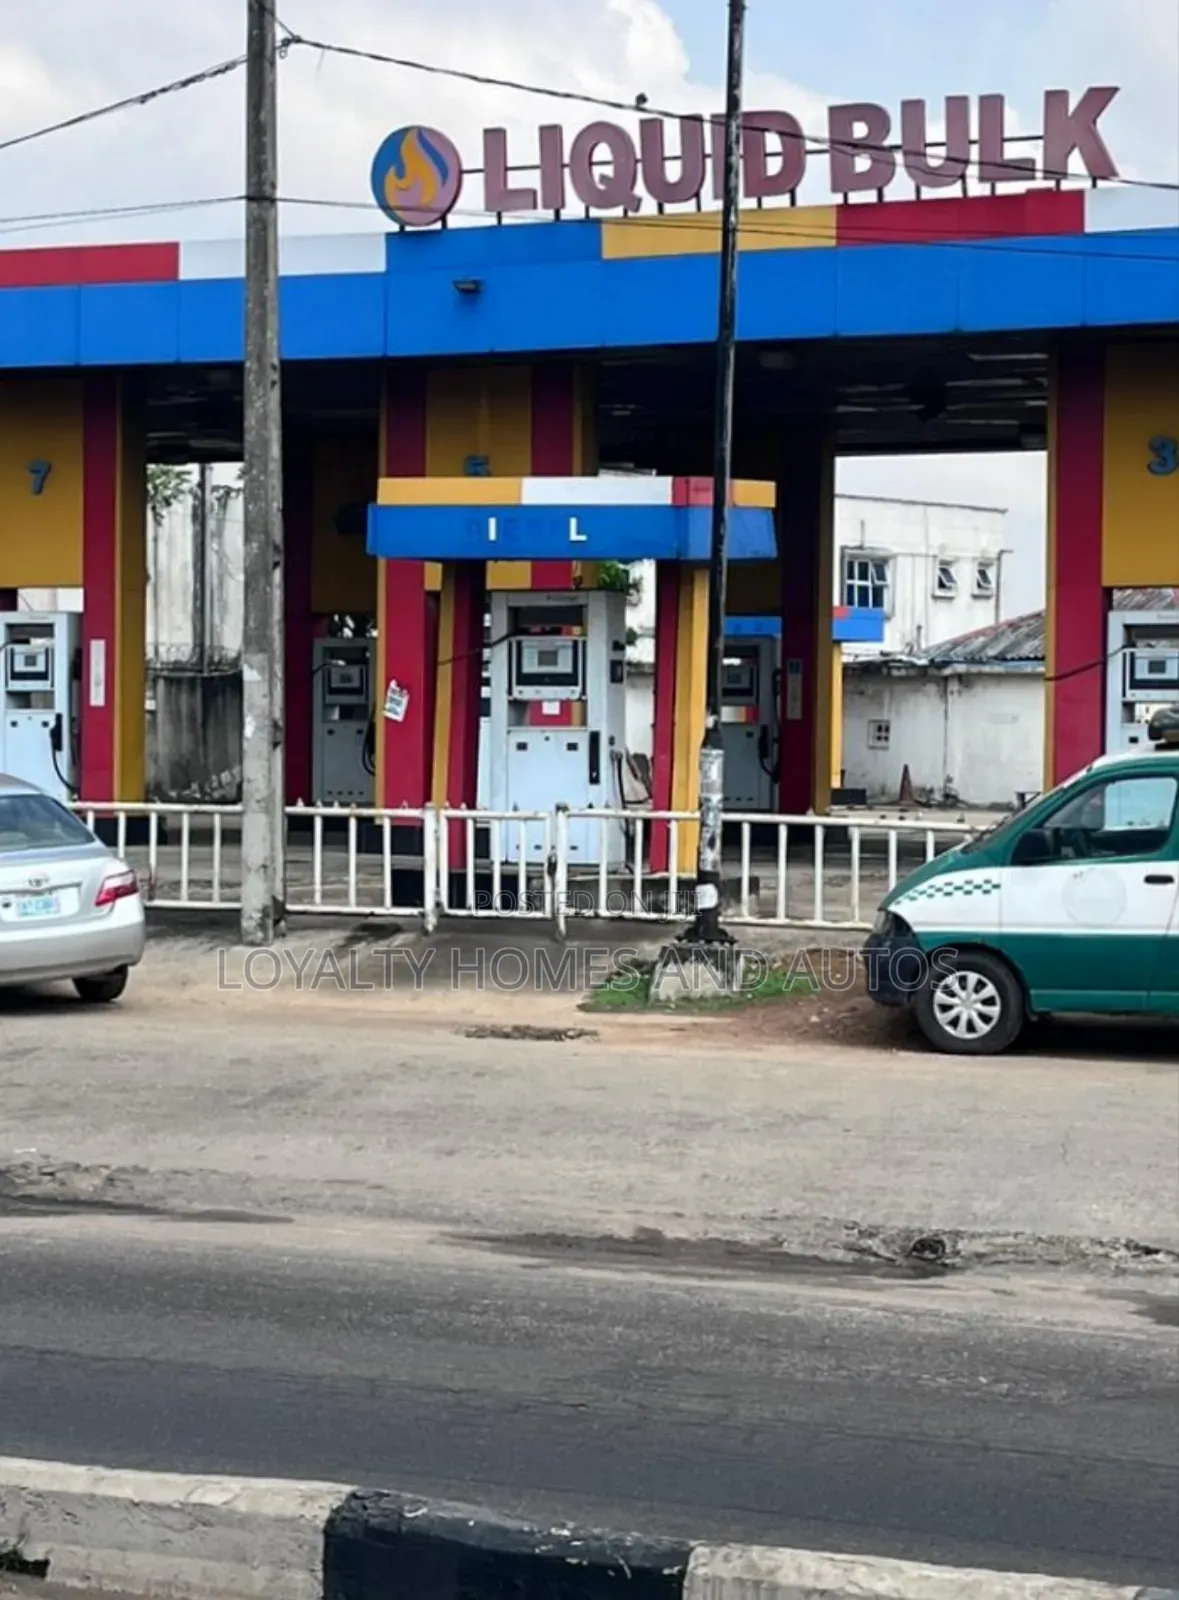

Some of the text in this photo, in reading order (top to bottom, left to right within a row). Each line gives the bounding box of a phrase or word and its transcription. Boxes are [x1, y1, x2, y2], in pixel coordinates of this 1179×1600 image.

[483, 86, 1120, 214] LIQUID BULK
[1148, 437, 1177, 476] 3
[28, 460, 52, 496] 7
